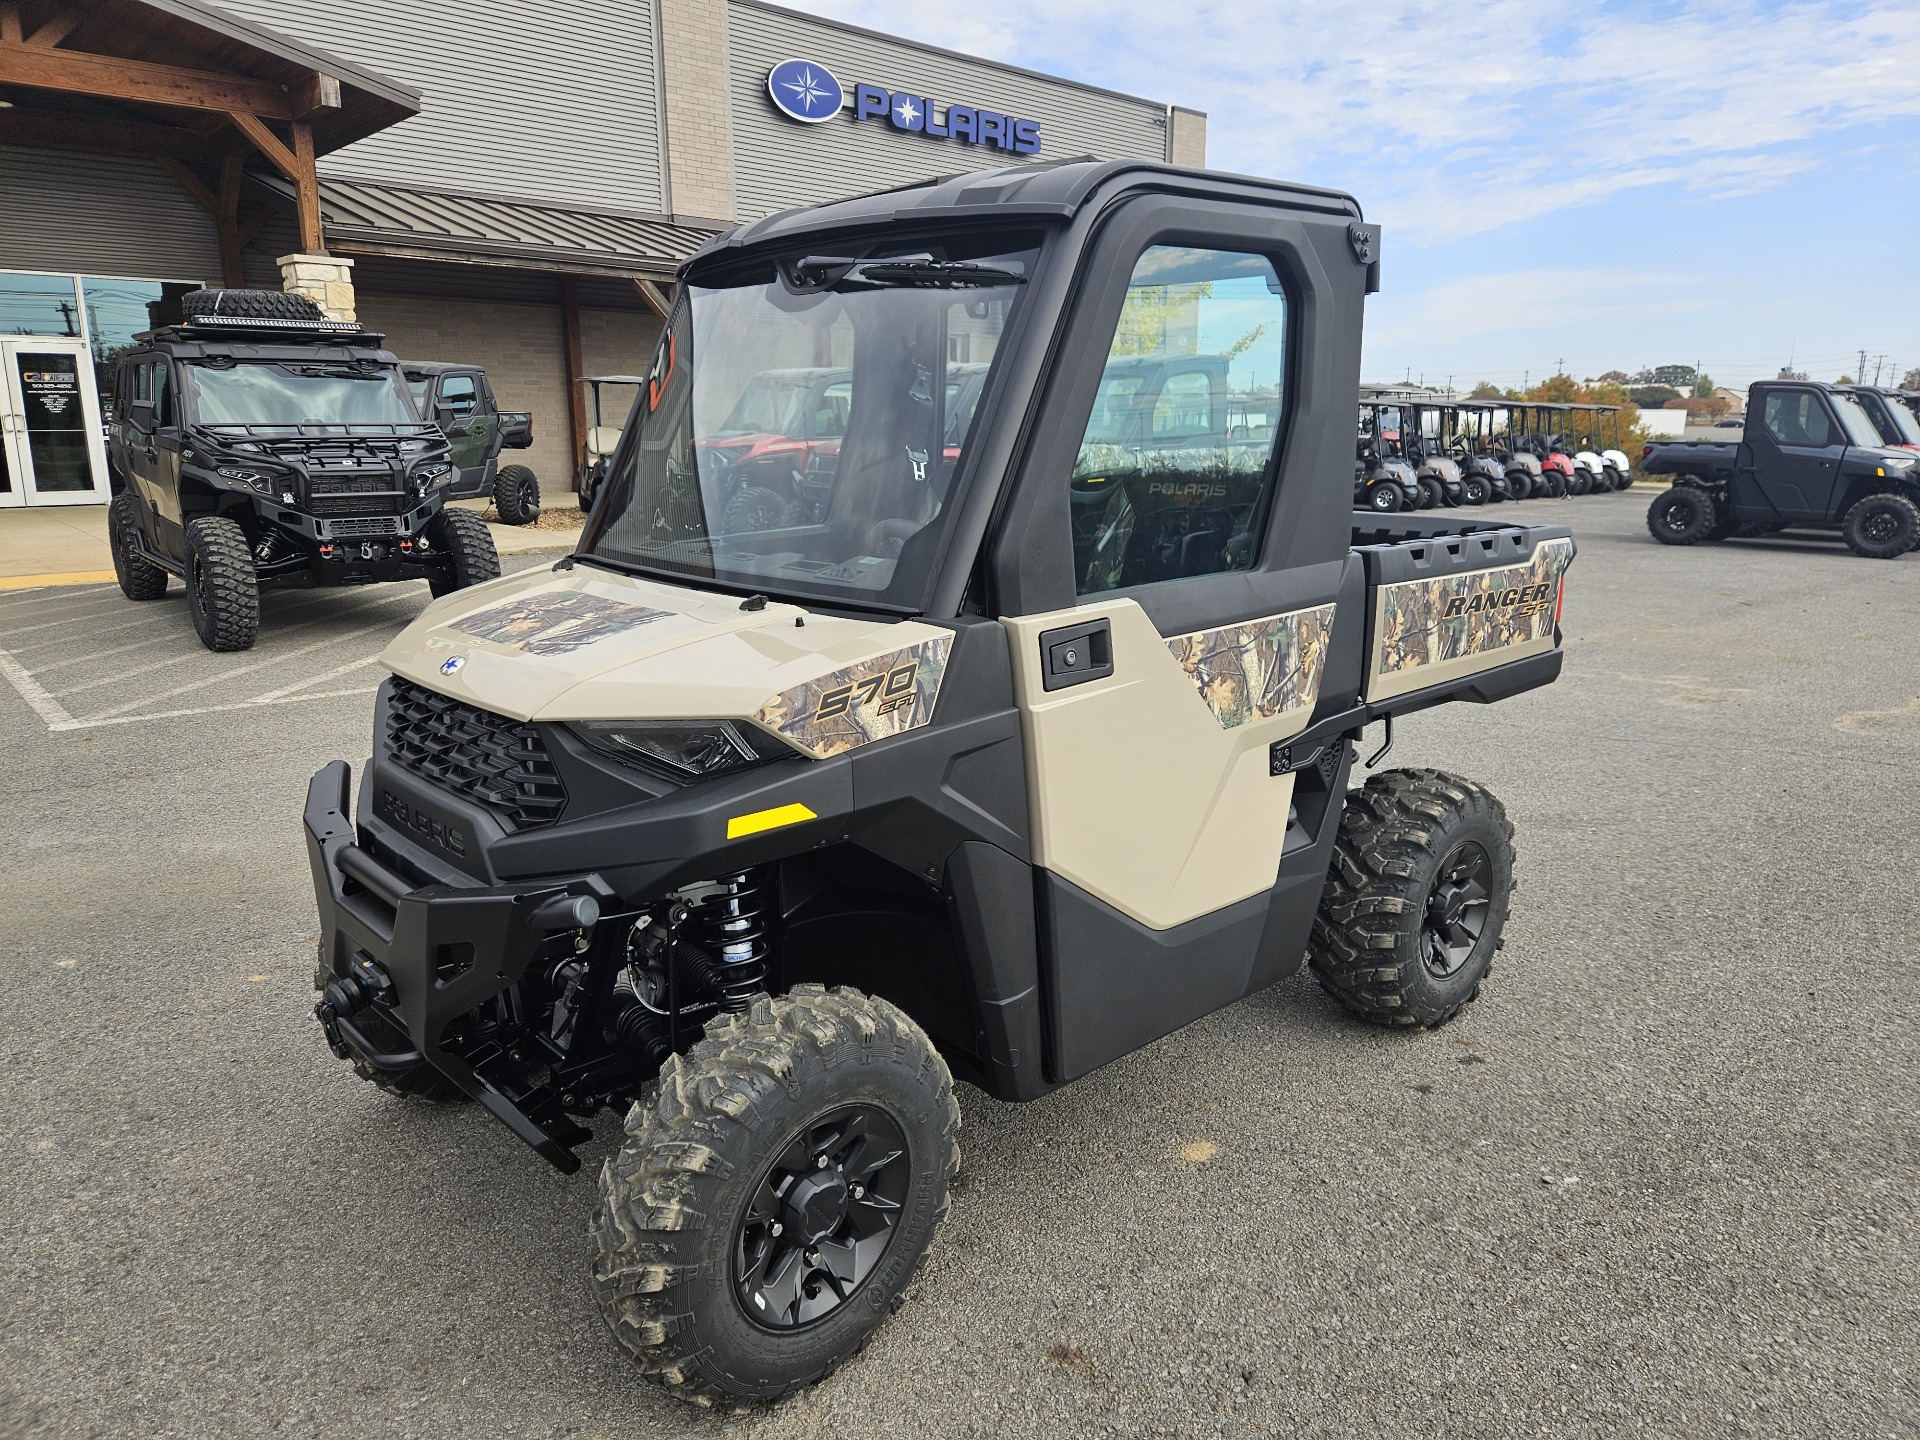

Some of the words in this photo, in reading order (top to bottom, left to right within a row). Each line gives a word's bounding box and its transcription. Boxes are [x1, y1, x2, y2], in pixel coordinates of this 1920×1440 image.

[855, 83, 1042, 155] POLARIS
[318, 483, 388, 494] POLARIS
[1149, 483, 1227, 496] POLARIS
[1442, 582, 1551, 619] RANGER
[1519, 602, 1550, 618] SP
[813, 662, 919, 724] 570
[877, 693, 917, 717] EFI
[383, 789, 466, 858] POLARIS
